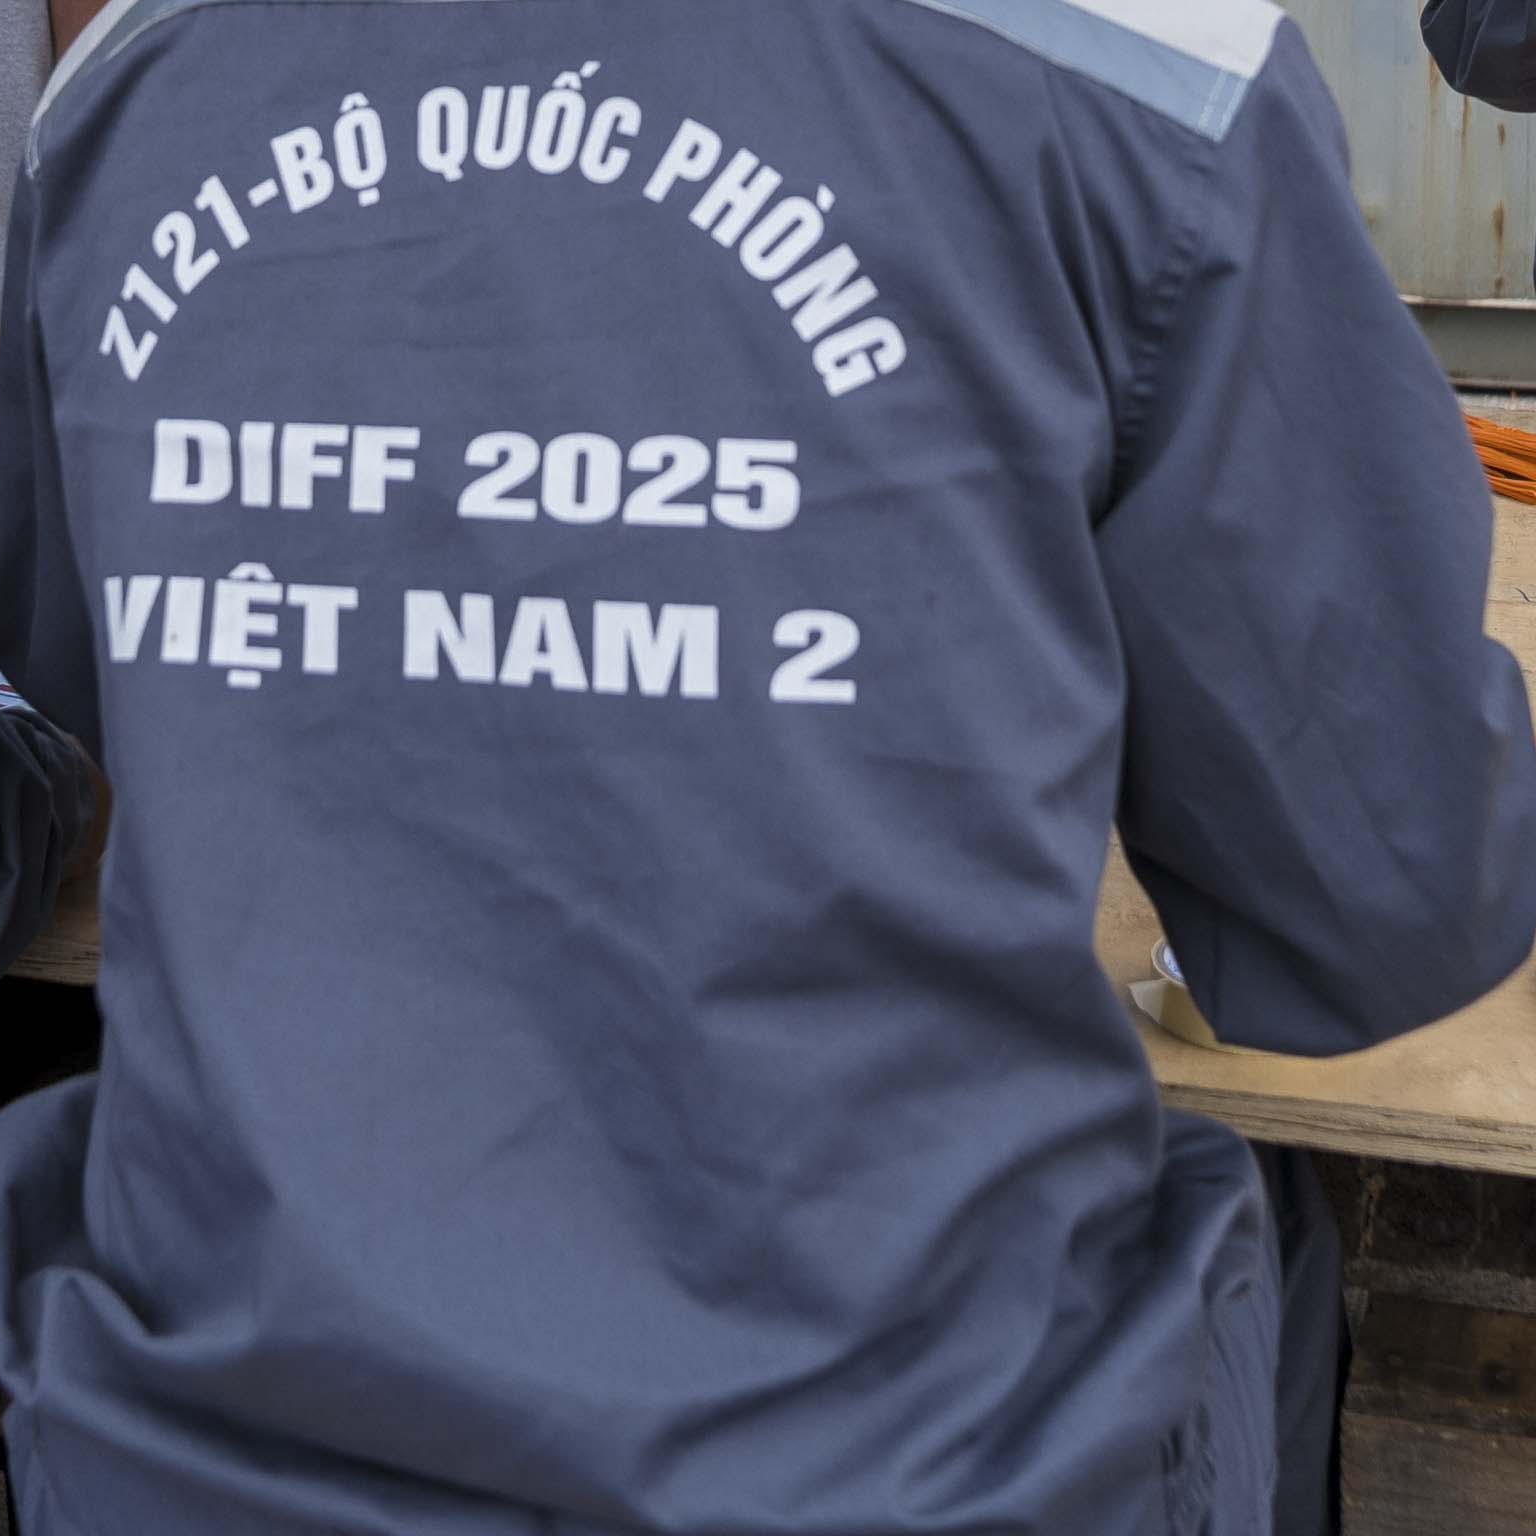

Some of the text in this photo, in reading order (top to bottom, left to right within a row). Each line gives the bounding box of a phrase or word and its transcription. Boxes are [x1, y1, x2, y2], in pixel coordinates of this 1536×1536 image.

[99, 60, 907, 397] Z121-BỘ QUỐC PHÒNG
[150, 418, 801, 530] DIFF 2025
[104, 562, 860, 704] VIỆT NAM 2
